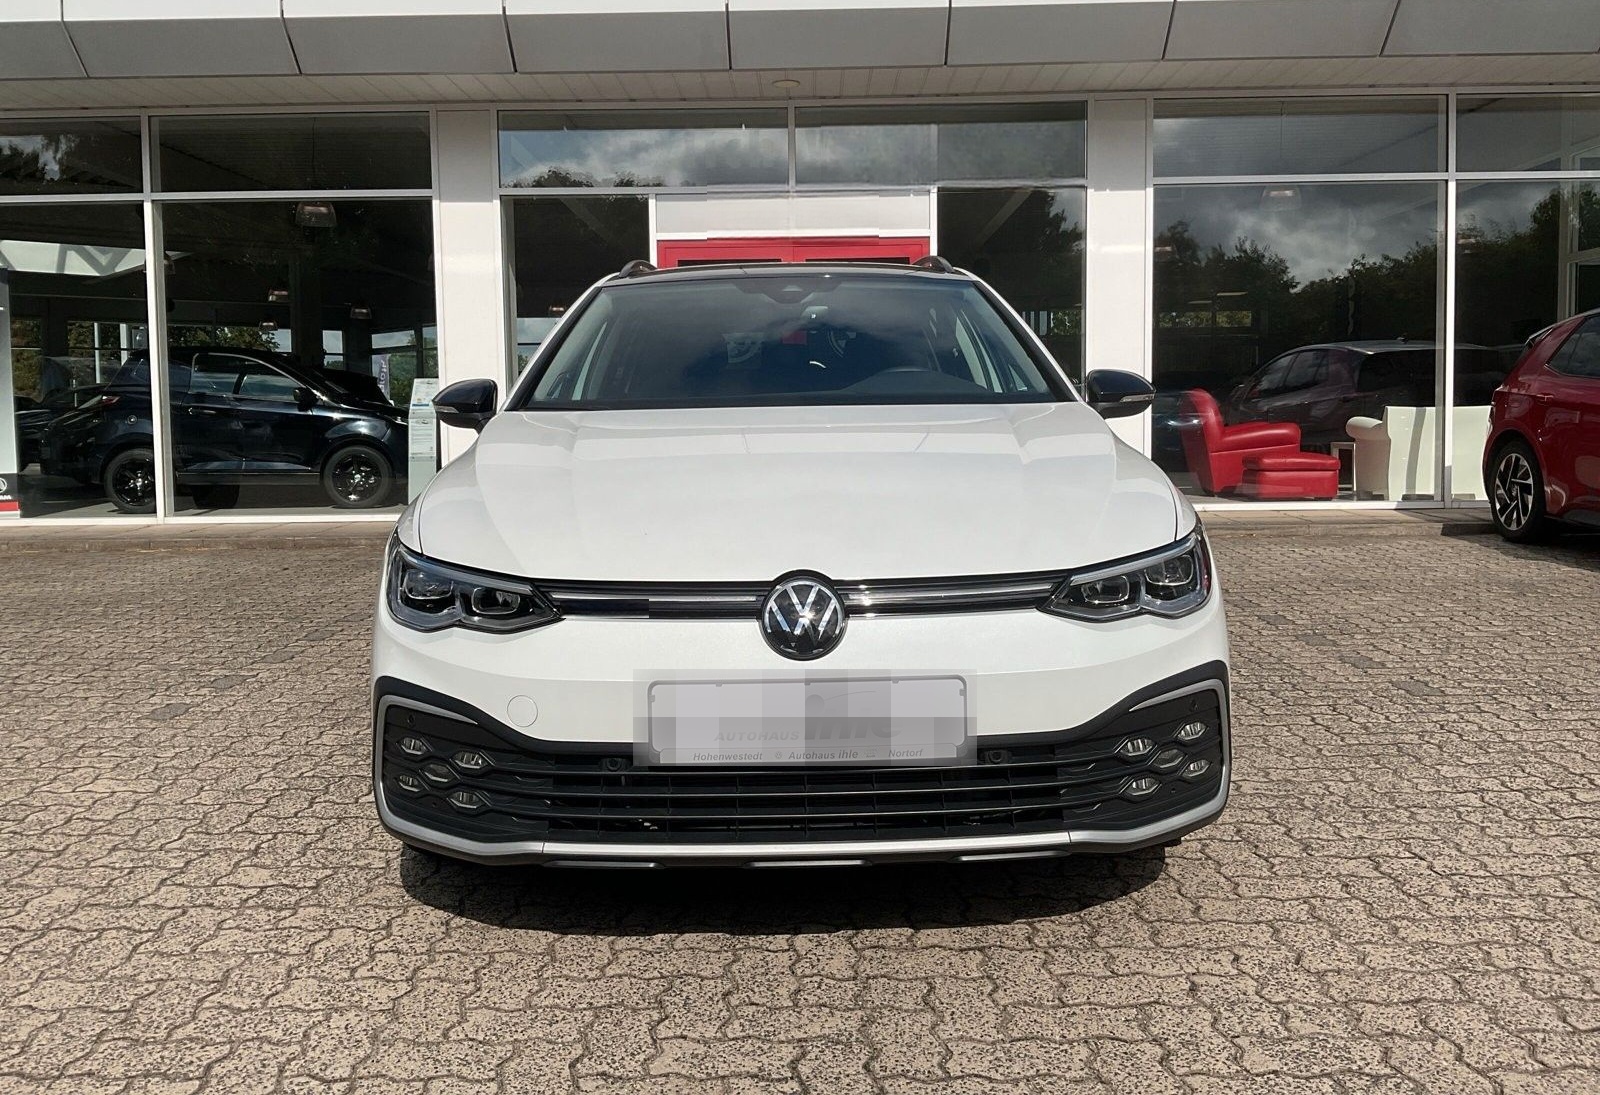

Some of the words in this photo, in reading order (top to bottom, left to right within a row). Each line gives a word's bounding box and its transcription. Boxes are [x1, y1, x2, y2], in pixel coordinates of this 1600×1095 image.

[714, 730, 800, 742] AUTOHAUS
[693, 752, 763, 761] Hohenwestedt
[788, 751, 836, 760] Autohaus
[838, 749, 859, 759] ihle
[888, 749, 923, 758] Nortorf
